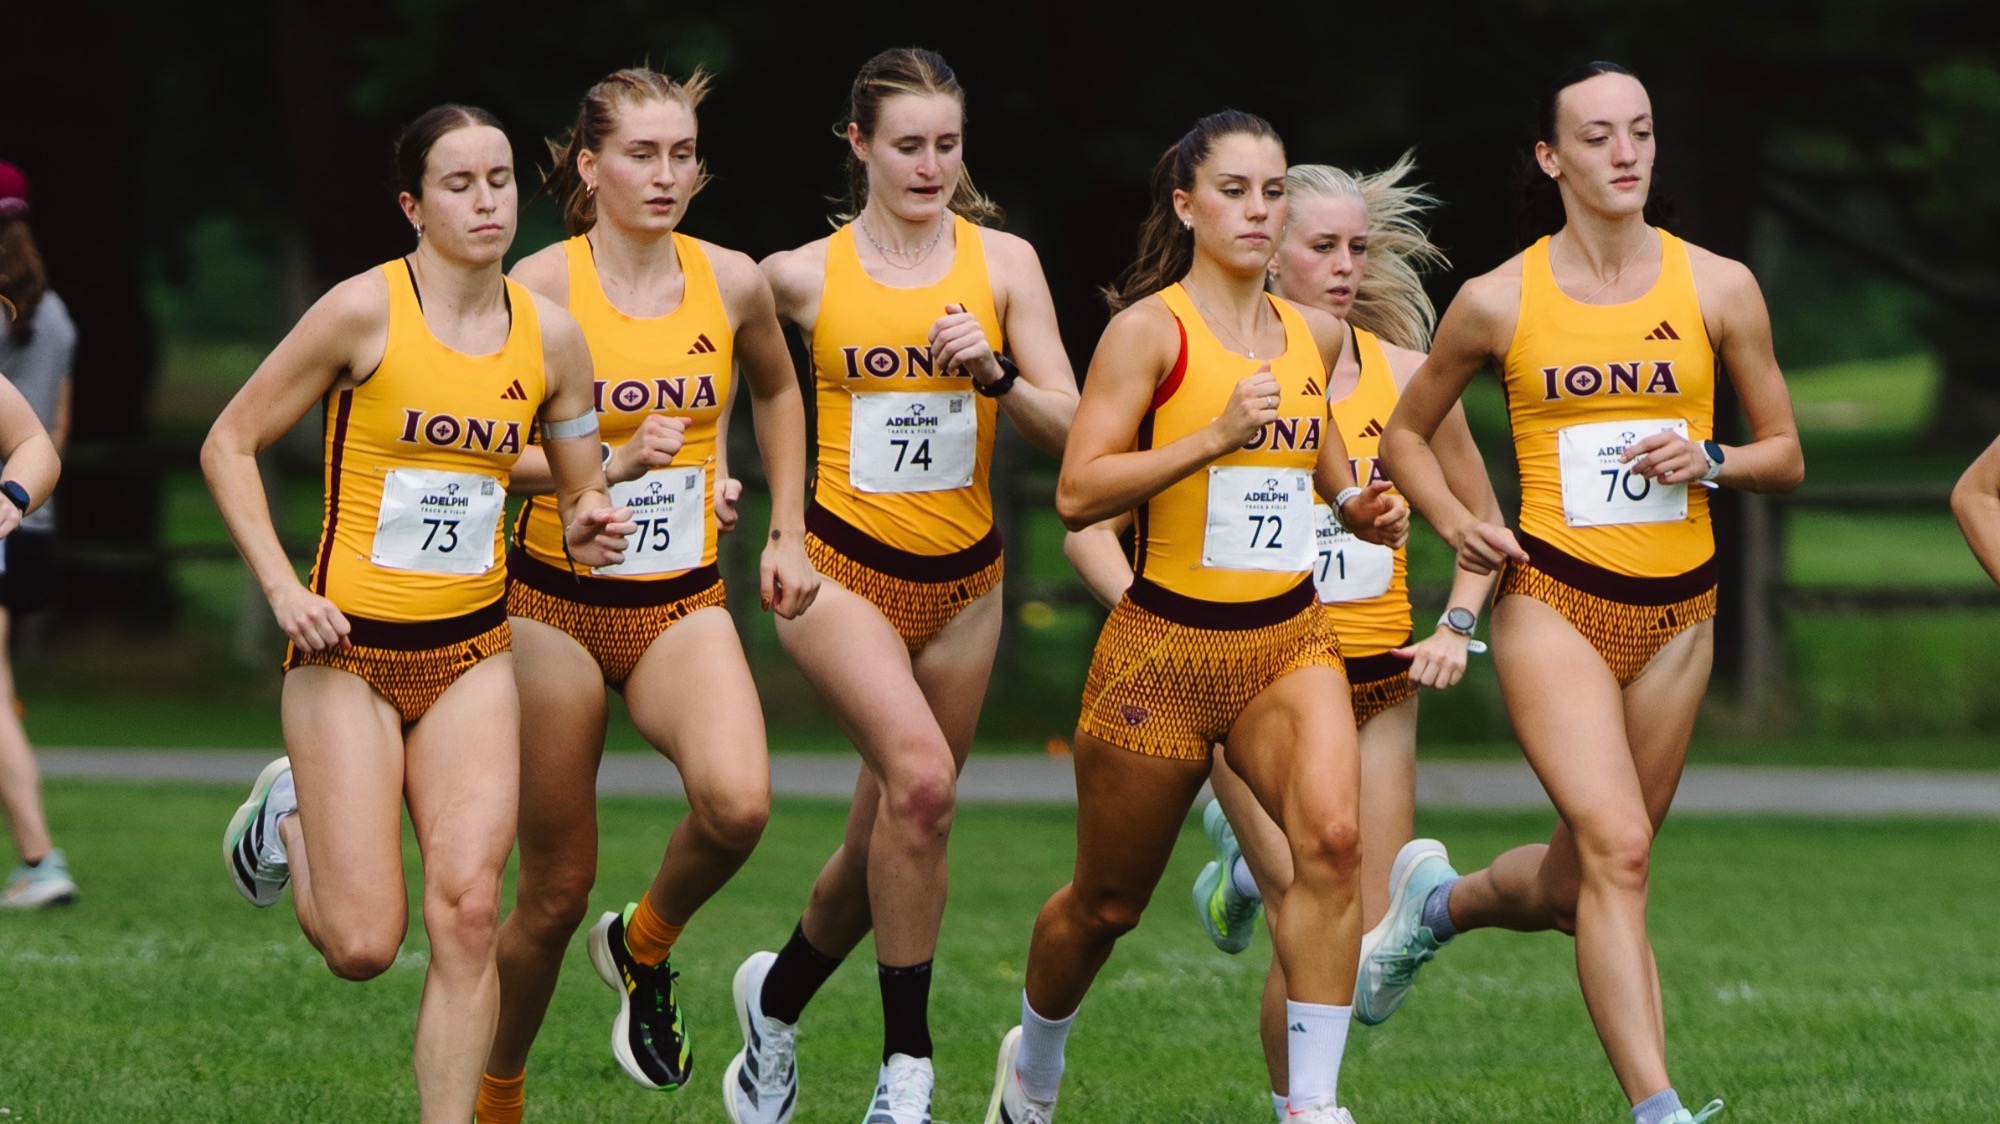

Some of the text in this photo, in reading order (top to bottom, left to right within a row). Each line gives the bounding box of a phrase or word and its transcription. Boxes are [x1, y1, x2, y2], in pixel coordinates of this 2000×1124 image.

[841, 345, 973, 379] ION
[594, 374, 719, 413] IONA
[1542, 361, 1681, 400] IONA
[398, 409, 521, 455] IONA
[886, 416, 938, 427] ADELPHI
[890, 438, 932, 472] 74
[420, 495, 469, 507] ADELPHI
[626, 493, 675, 507] ADELPHI
[1244, 492, 1289, 503] ADELPHI
[1600, 469, 1651, 502] 70
[421, 518, 460, 553] 73
[635, 517, 670, 553] 75
[1248, 515, 1283, 548] 72
[1319, 549, 1345, 582] 71
